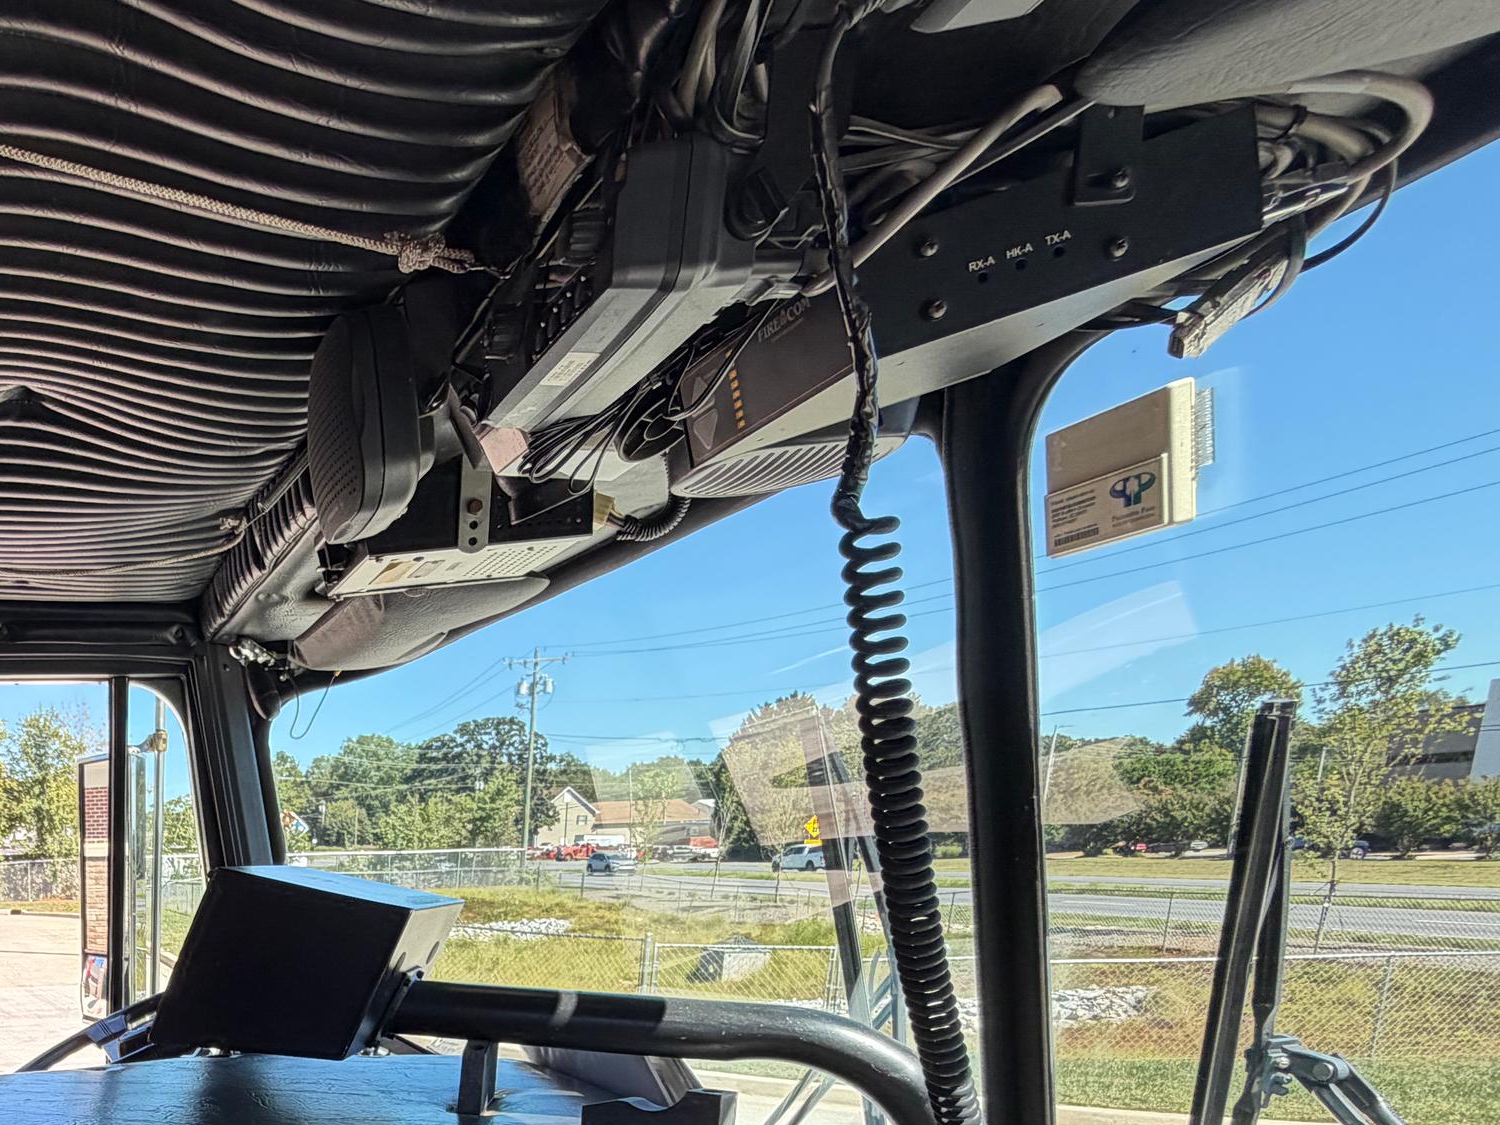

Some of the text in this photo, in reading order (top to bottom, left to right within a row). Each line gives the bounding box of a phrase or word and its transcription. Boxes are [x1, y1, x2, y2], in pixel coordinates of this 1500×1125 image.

[968, 230, 1072, 272] RX-A HK-A TX-A
